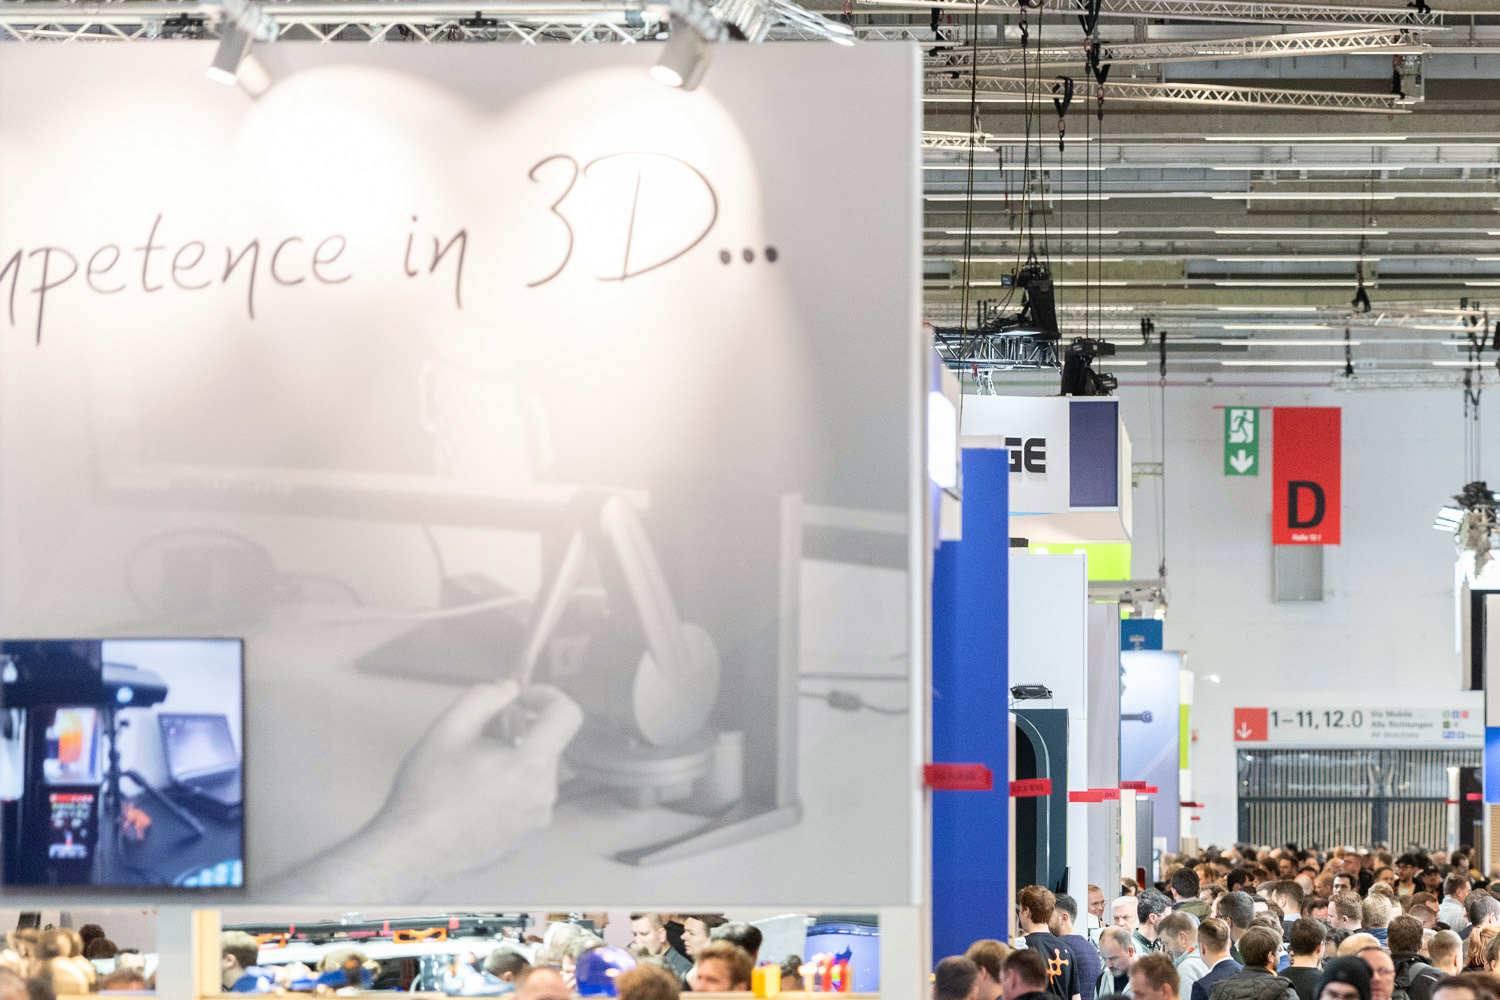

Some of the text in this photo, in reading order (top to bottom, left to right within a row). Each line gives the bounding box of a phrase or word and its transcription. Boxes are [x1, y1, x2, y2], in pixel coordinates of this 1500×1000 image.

[402, 215, 468, 310] in
[527, 151, 780, 289] 3D...
[1004, 437, 1046, 474] GE
[1287, 480, 1326, 529] D
[1325, 710, 1364, 728] 12.0
